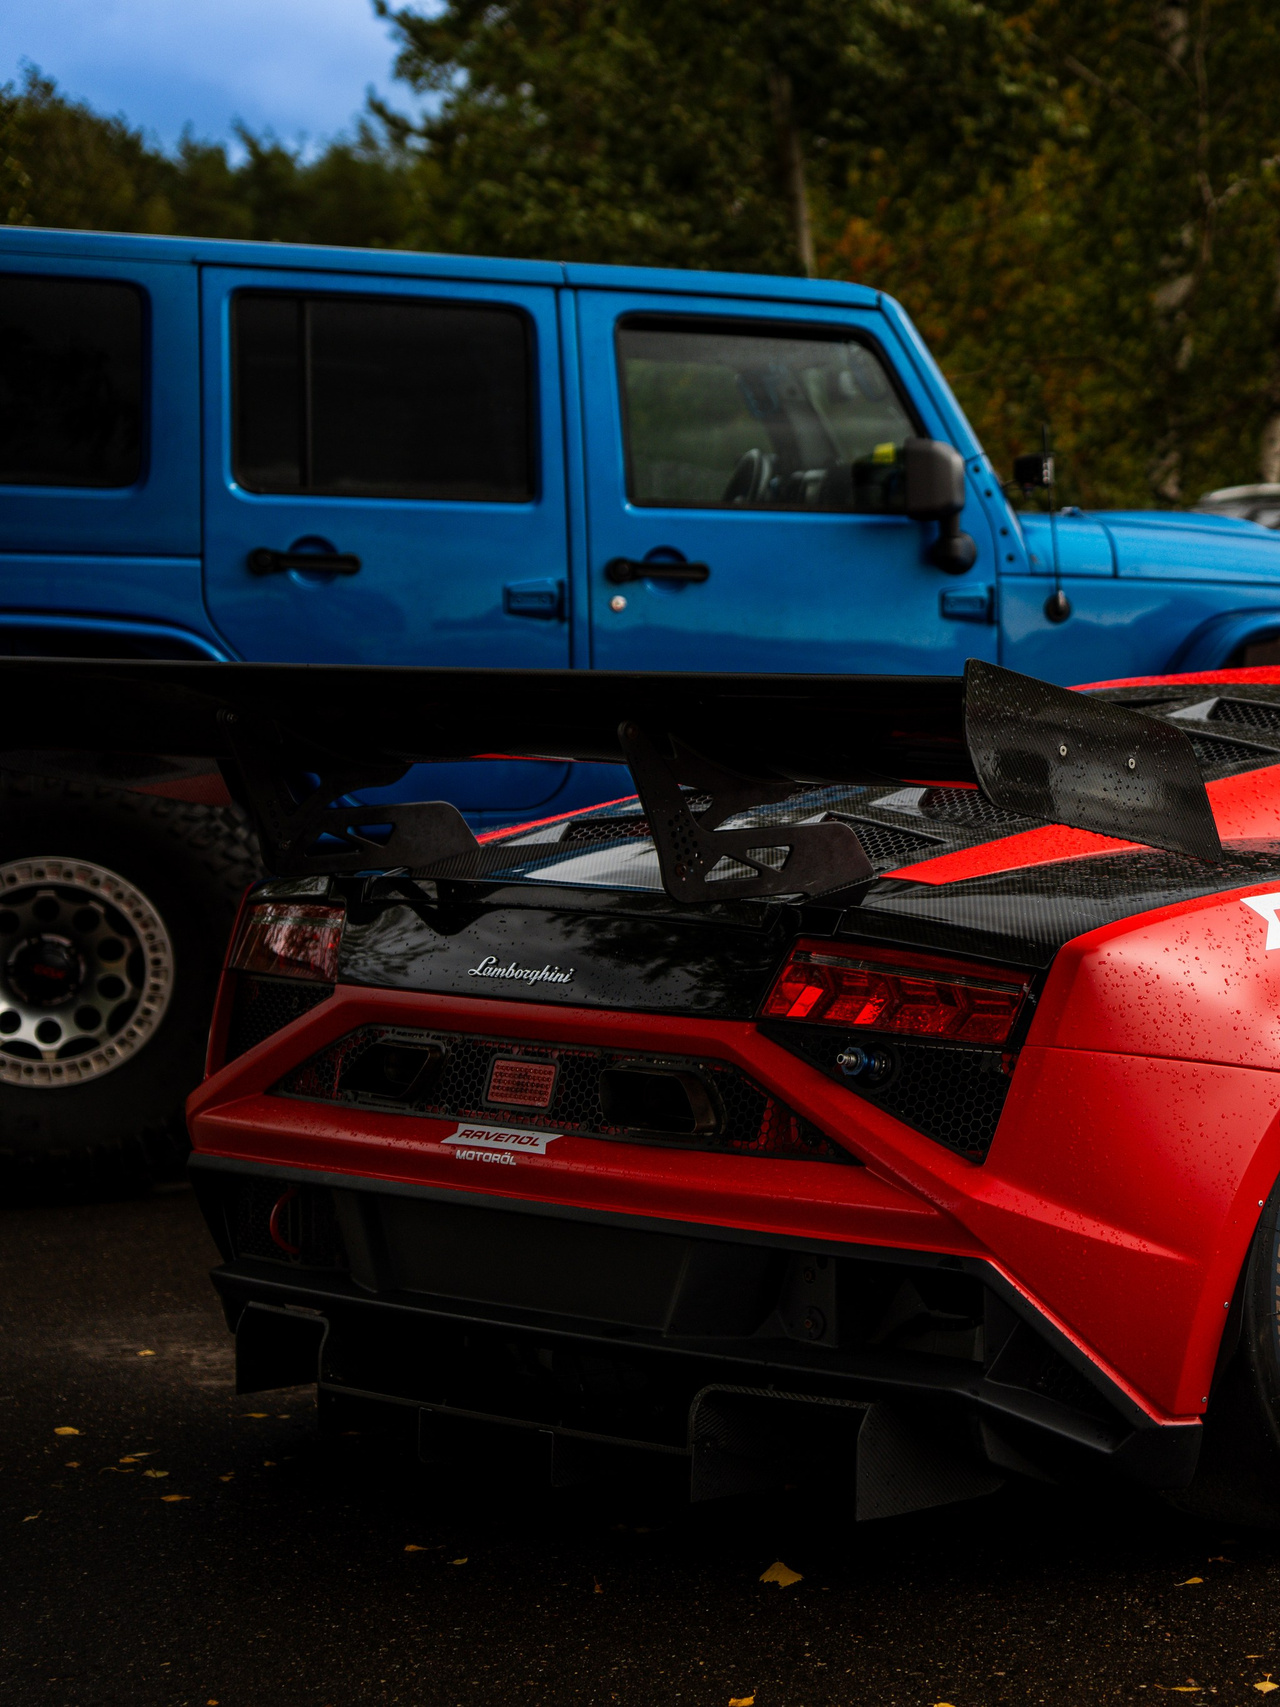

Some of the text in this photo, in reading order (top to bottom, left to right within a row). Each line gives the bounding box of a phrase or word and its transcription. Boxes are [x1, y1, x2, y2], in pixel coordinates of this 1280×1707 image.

[468, 956, 575, 986] Lamborghini
[458, 1129, 540, 1147] RAVENOL
[455, 1149, 517, 1166] MOTORÖL
